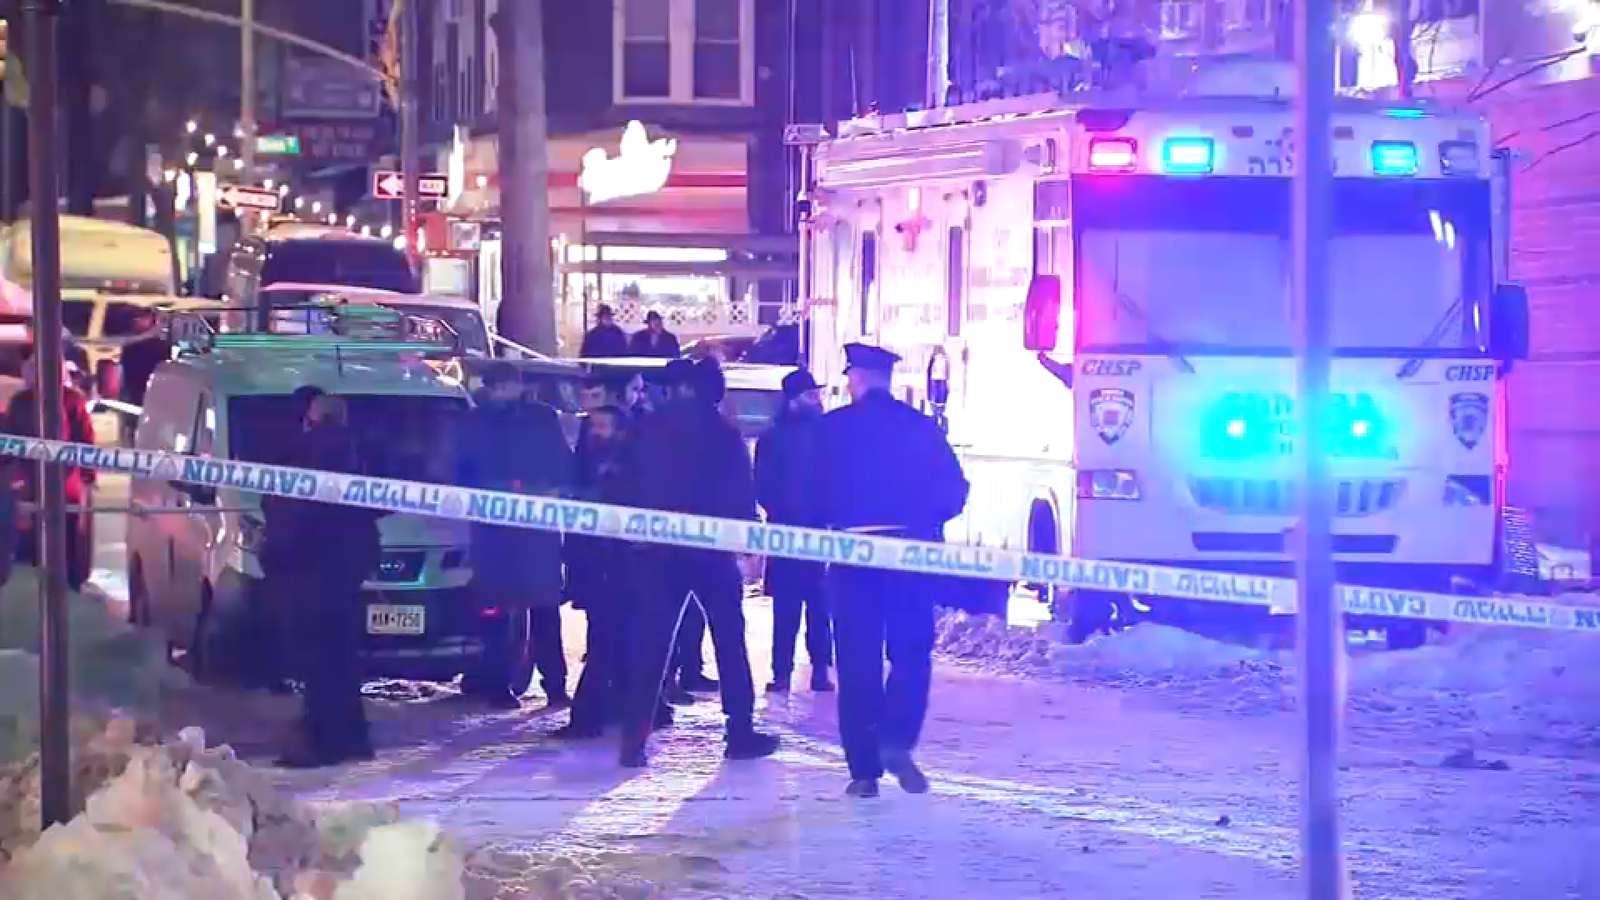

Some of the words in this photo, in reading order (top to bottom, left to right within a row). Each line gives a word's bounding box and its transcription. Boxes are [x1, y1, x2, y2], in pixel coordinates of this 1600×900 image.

[1082, 359, 1142, 376] CHSP
[1445, 364, 1494, 381] CHSP
[183, 458, 318, 496] CAUTION
[467, 492, 600, 531] CAUTION
[746, 526, 874, 562] CAUTION
[1021, 554, 1150, 590] CAUTION
